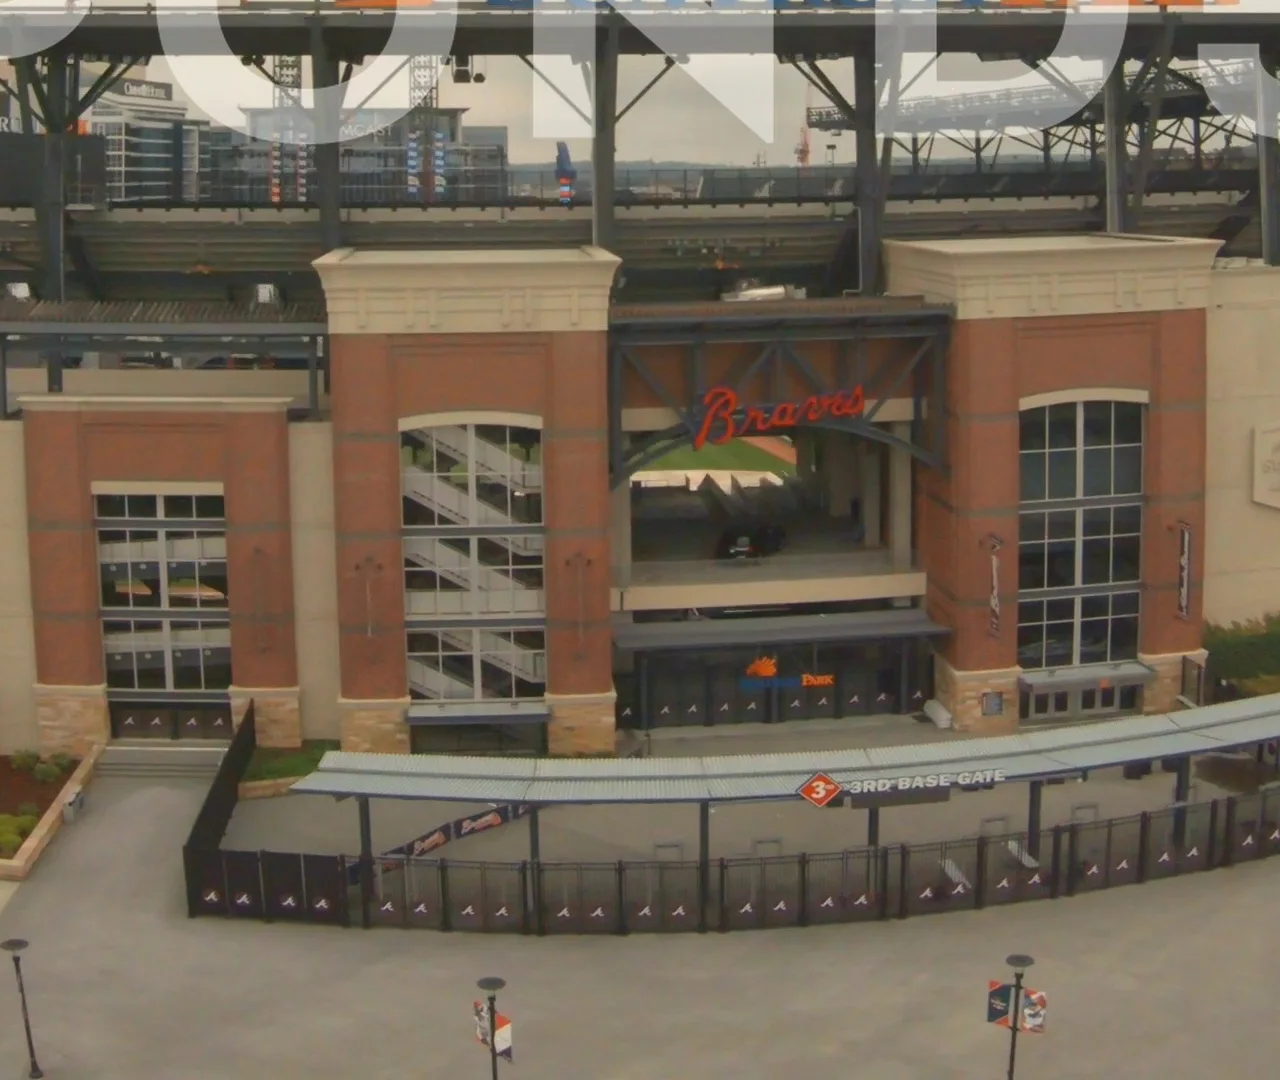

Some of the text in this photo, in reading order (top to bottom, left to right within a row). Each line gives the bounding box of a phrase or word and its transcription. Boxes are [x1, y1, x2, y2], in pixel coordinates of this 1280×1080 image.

[692, 383, 866, 451] Braves
[849, 769, 1006, 795] 3RD BASE GATE
